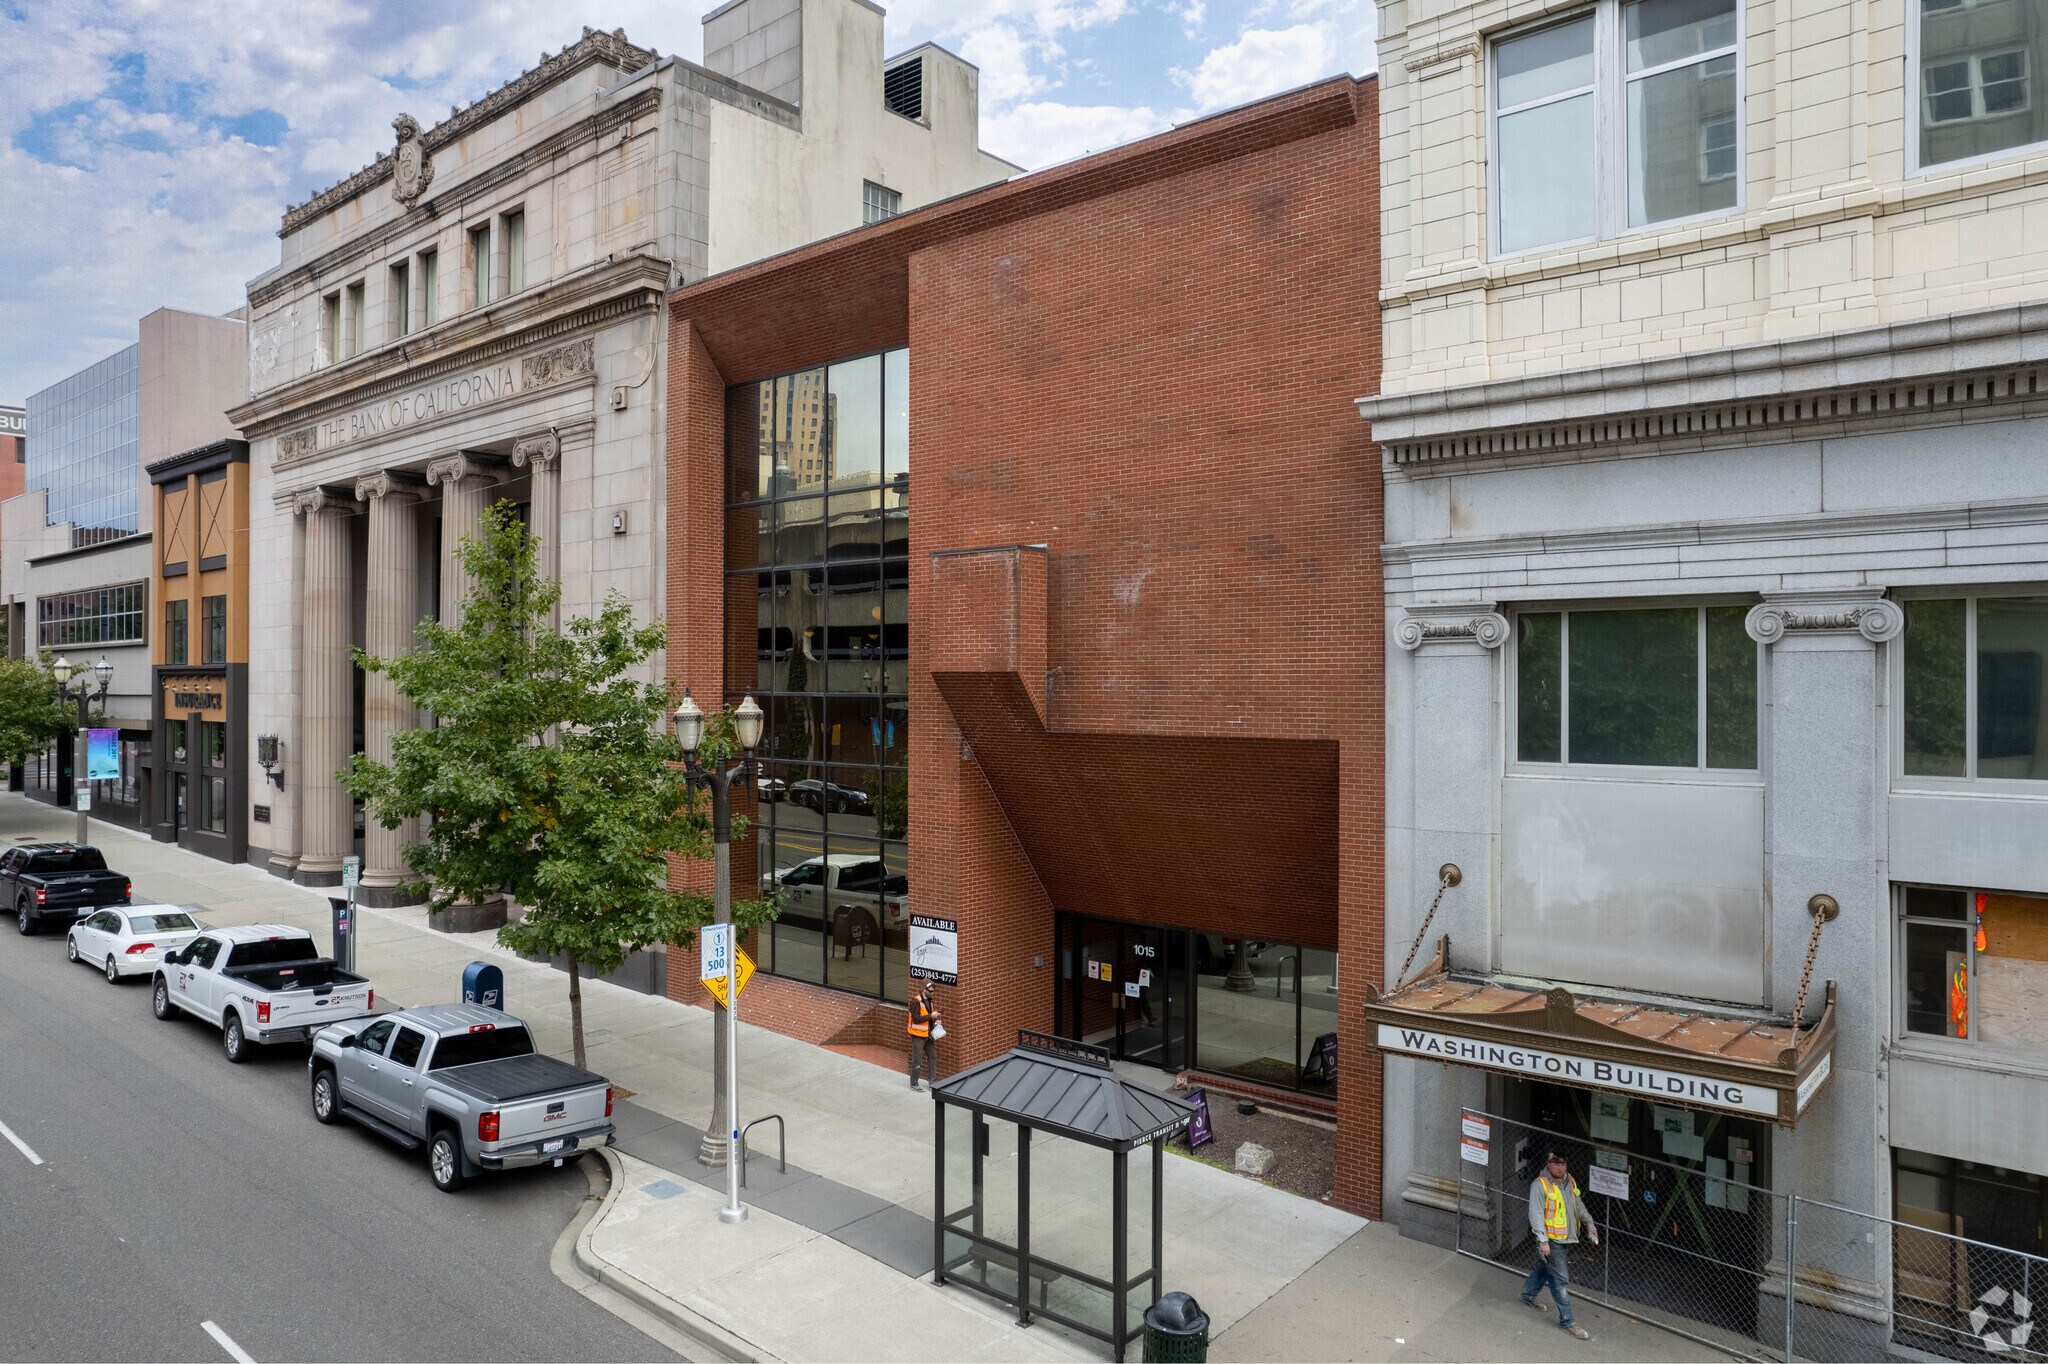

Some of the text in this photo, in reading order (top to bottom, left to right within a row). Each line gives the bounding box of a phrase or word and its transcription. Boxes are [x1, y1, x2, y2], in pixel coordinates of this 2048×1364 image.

[322, 365, 515, 448] THE BANK OF CALIFORNIA
[340, 910, 346, 918] P
[912, 915, 955, 931] AVAILABLE
[716, 934, 721, 944] 1
[715, 946, 725, 957] 13
[1133, 944, 1155, 958] 1015
[708, 959, 725, 971] 500
[911, 967, 957, 983] (253)843-4777
[341, 993, 367, 1001] KNUTSON
[1400, 1030, 1744, 1104] WASHINGTON BUILDING
[543, 1111, 567, 1123] GMC
[1133, 1134, 1152, 1147] PIERCE
[1153, 1124, 1175, 1138] TRANSIT
